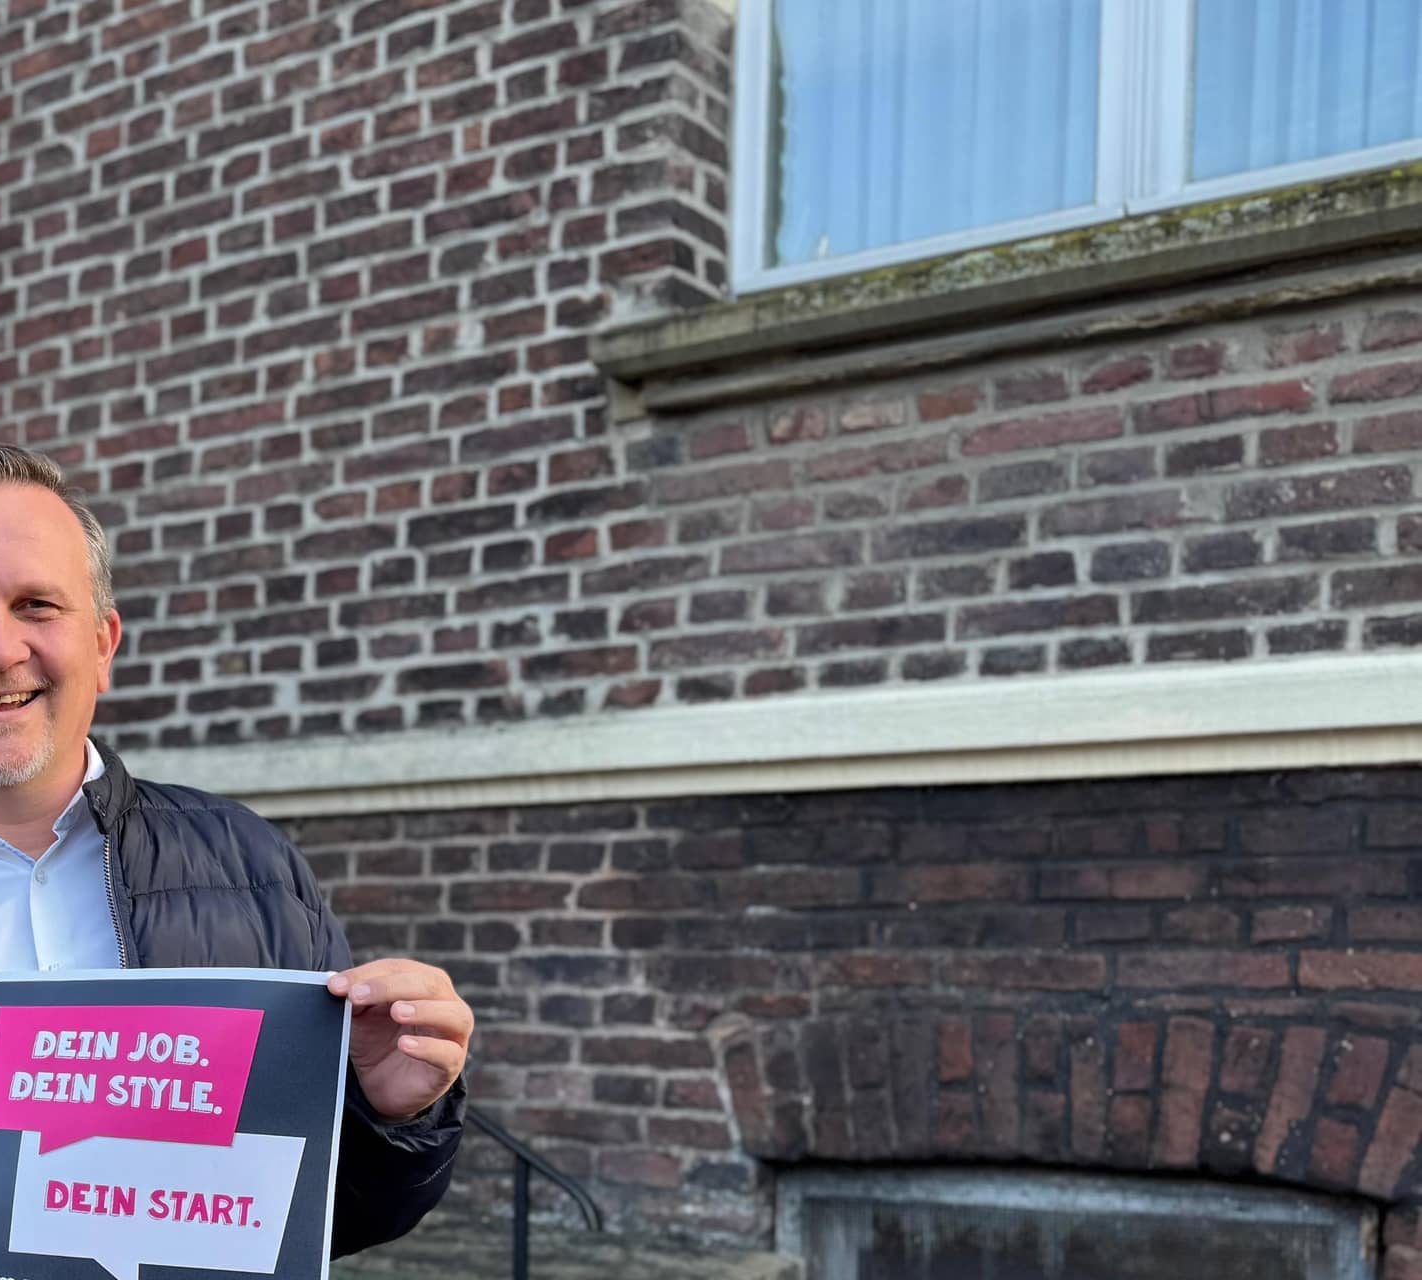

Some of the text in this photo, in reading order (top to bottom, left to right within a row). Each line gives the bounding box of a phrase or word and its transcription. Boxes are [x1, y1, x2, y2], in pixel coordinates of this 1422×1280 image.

[32, 1031, 210, 1067] DEIN JOB.
[9, 1071, 223, 1115] DEIN STYLE.
[44, 1180, 262, 1228] DEIN START.
